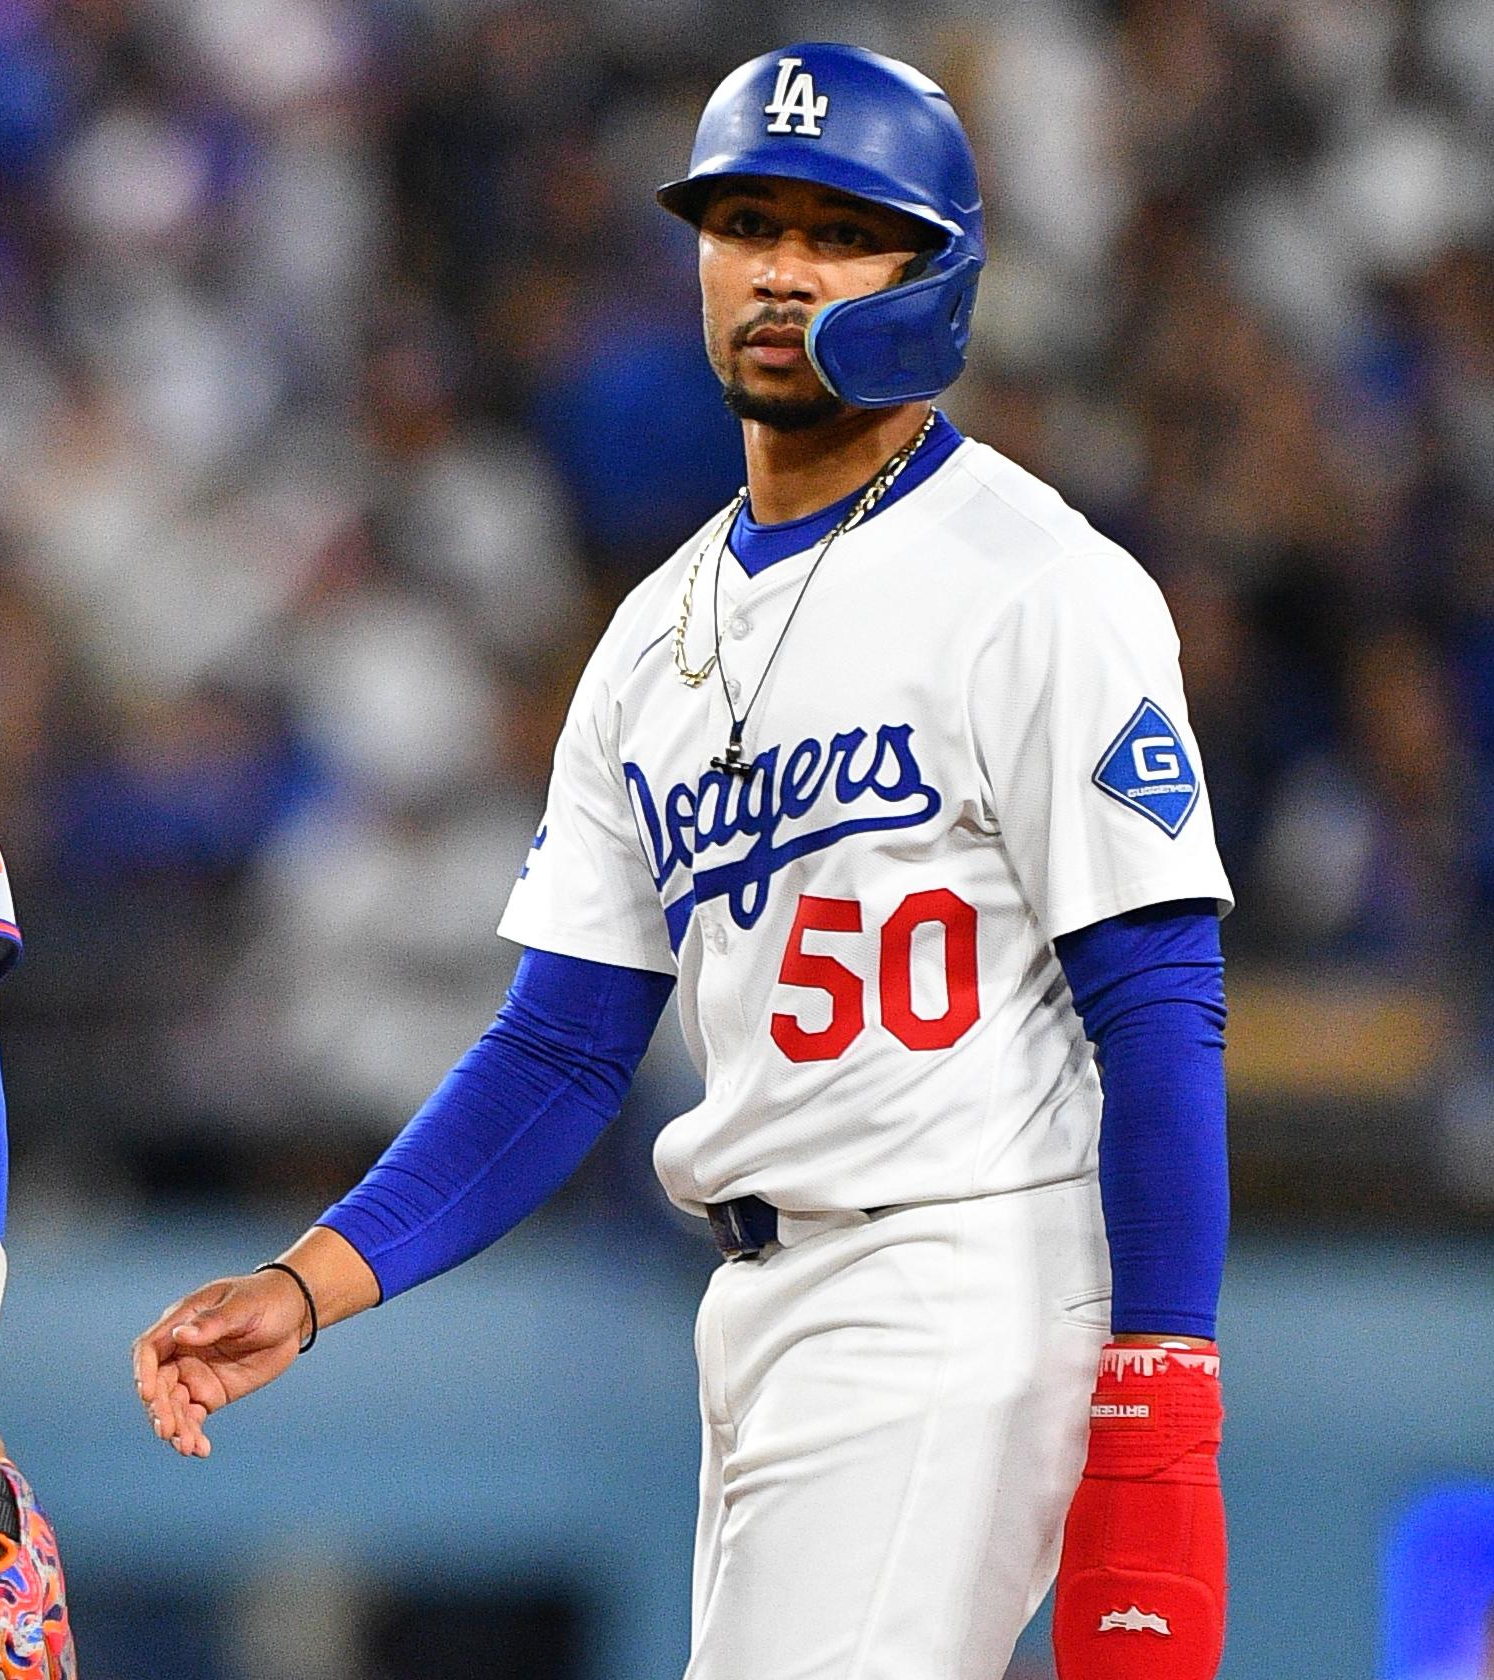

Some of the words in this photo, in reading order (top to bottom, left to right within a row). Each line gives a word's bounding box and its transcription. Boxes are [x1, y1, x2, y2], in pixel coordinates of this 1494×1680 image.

[765, 58, 829, 136] LA
[1132, 737, 1180, 781] G
[770, 887, 981, 1063] 50
